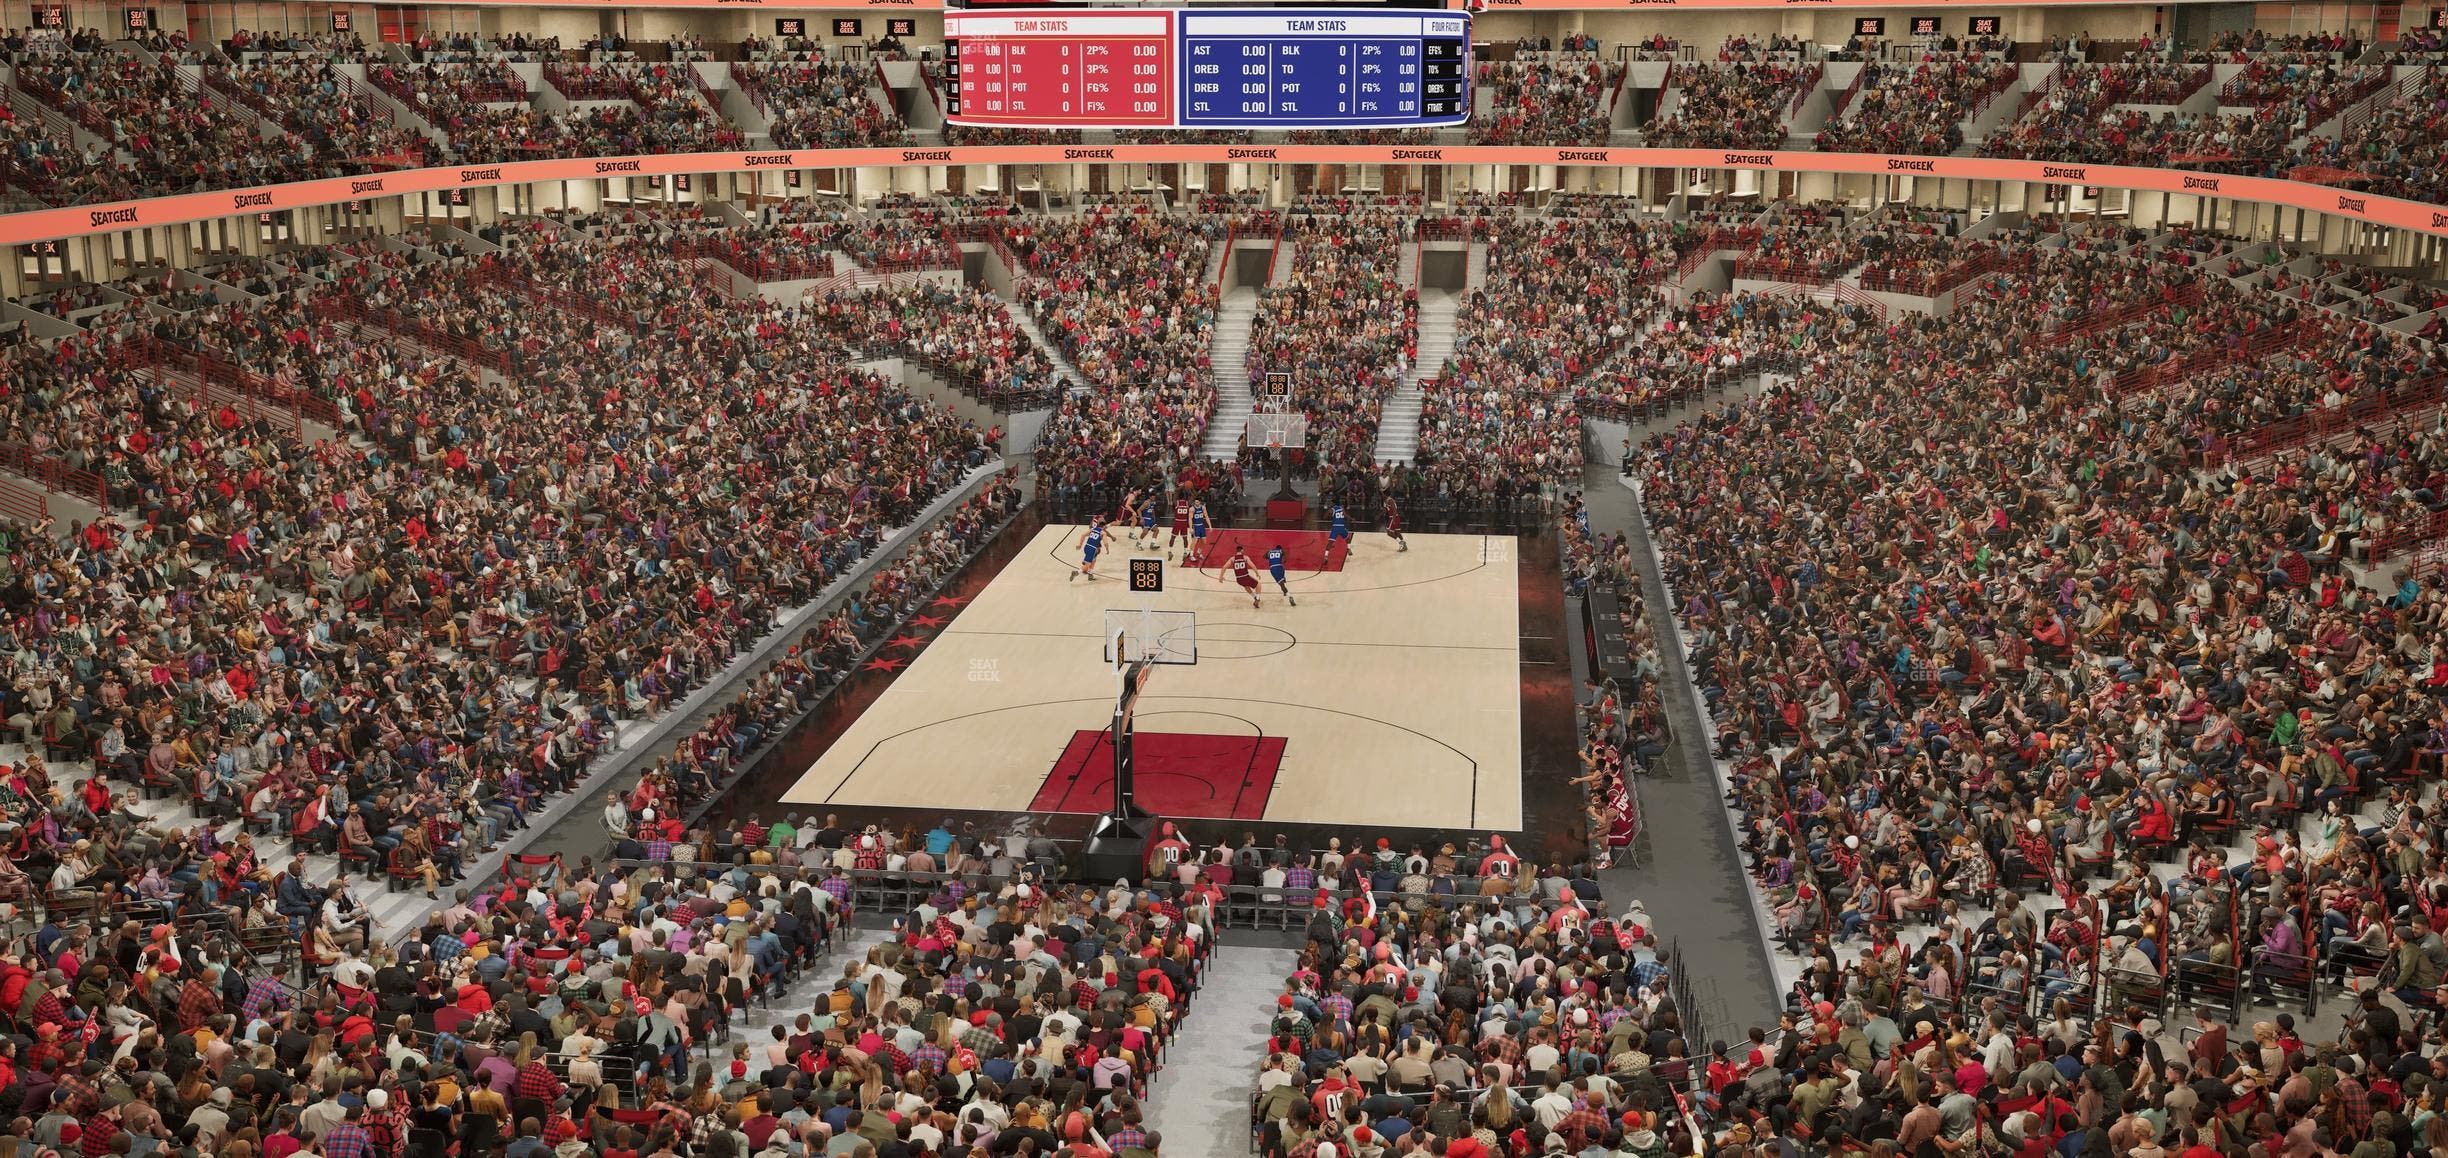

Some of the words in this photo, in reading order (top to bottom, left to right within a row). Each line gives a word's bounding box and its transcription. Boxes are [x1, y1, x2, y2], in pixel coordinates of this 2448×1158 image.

[1014, 21, 1037, 32] TEAM
[1040, 21, 1068, 32] STATS
[1287, 21, 1314, 32] TEAM
[1318, 21, 1346, 32] STATS
[1432, 22, 1444, 32] FOUR
[1012, 46, 1025, 55] BLK
[1062, 46, 1068, 56] 0
[1086, 46, 1108, 55] 2P%
[1134, 46, 1156, 56] 0.00
[1194, 46, 1211, 55] AST
[1242, 46, 1265, 56] 0.00
[1282, 46, 1300, 55] BLK
[1339, 46, 1346, 56] 0
[1362, 46, 1381, 55] 2P%
[1399, 46, 1415, 56] 0.00
[986, 64, 1000, 74] 0.00
[1012, 64, 1021, 74] TO
[1062, 64, 1068, 75] 0
[1087, 64, 1108, 74] 3P%
[1134, 64, 1156, 75] 0.00
[1194, 65, 1219, 74] OREB
[1242, 64, 1265, 75] 0.00
[1282, 65, 1294, 74] TO
[1339, 64, 1346, 75] 0
[1362, 65, 1381, 74] 3P%
[1399, 64, 1415, 75] 0.00
[986, 82, 1001, 92] 0.00
[1012, 83, 1026, 92] POT
[1062, 84, 1069, 94] 0
[1087, 83, 1109, 92] FG%
[1134, 83, 1156, 94] 0.00
[1194, 84, 1219, 92] DREB
[1242, 83, 1265, 94] 0.00
[1282, 84, 1300, 92] POT
[1339, 83, 1346, 94] 0
[1362, 84, 1381, 92] FG%
[1399, 83, 1414, 94] 0.00
[987, 101, 1001, 111] 0.00
[1013, 101, 1025, 110] STL
[1062, 102, 1069, 112] 0
[1088, 102, 1105, 111] Fi%
[1134, 102, 1156, 112] 0.00
[1194, 102, 1210, 112] STL
[1242, 102, 1265, 112] 0.00
[1282, 102, 1298, 112] STL
[1339, 102, 1346, 112] 0
[1362, 102, 1377, 112] Fi%
[1399, 102, 1414, 112] 0.00
[902, 150, 952, 162] SEATGEEK
[1064, 148, 1114, 160] SEATGEEK
[1228, 148, 1277, 160] SEATGEEK
[1392, 149, 1442, 160] SEATGEEK
[1558, 150, 1608, 162] SEATGEEK
[744, 154, 792, 167] SEATGEEK
[1724, 154, 1773, 166] SEATGEEK
[1888, 158, 1934, 172] SEATGEEK
[596, 160, 640, 174] SEATGEEK
[461, 168, 500, 183] SEATGEEK
[2043, 166, 2085, 180] SEATGEEK
[351, 178, 384, 194] SEATGEEK
[2183, 176, 2219, 192] SEATGEEK
[234, 191, 272, 209] SEATGEEK
[2338, 196, 2366, 214] SEATGEEK
[90, 207, 138, 227] SEATGEEK
[1272, 383, 1283, 394] 88
[1133, 562, 1145, 571] 88
[1147, 562, 1160, 571] 88
[1234, 562, 1245, 570] 00
[1136, 573, 1156, 587] 88
[1164, 847, 1178, 862] 00
